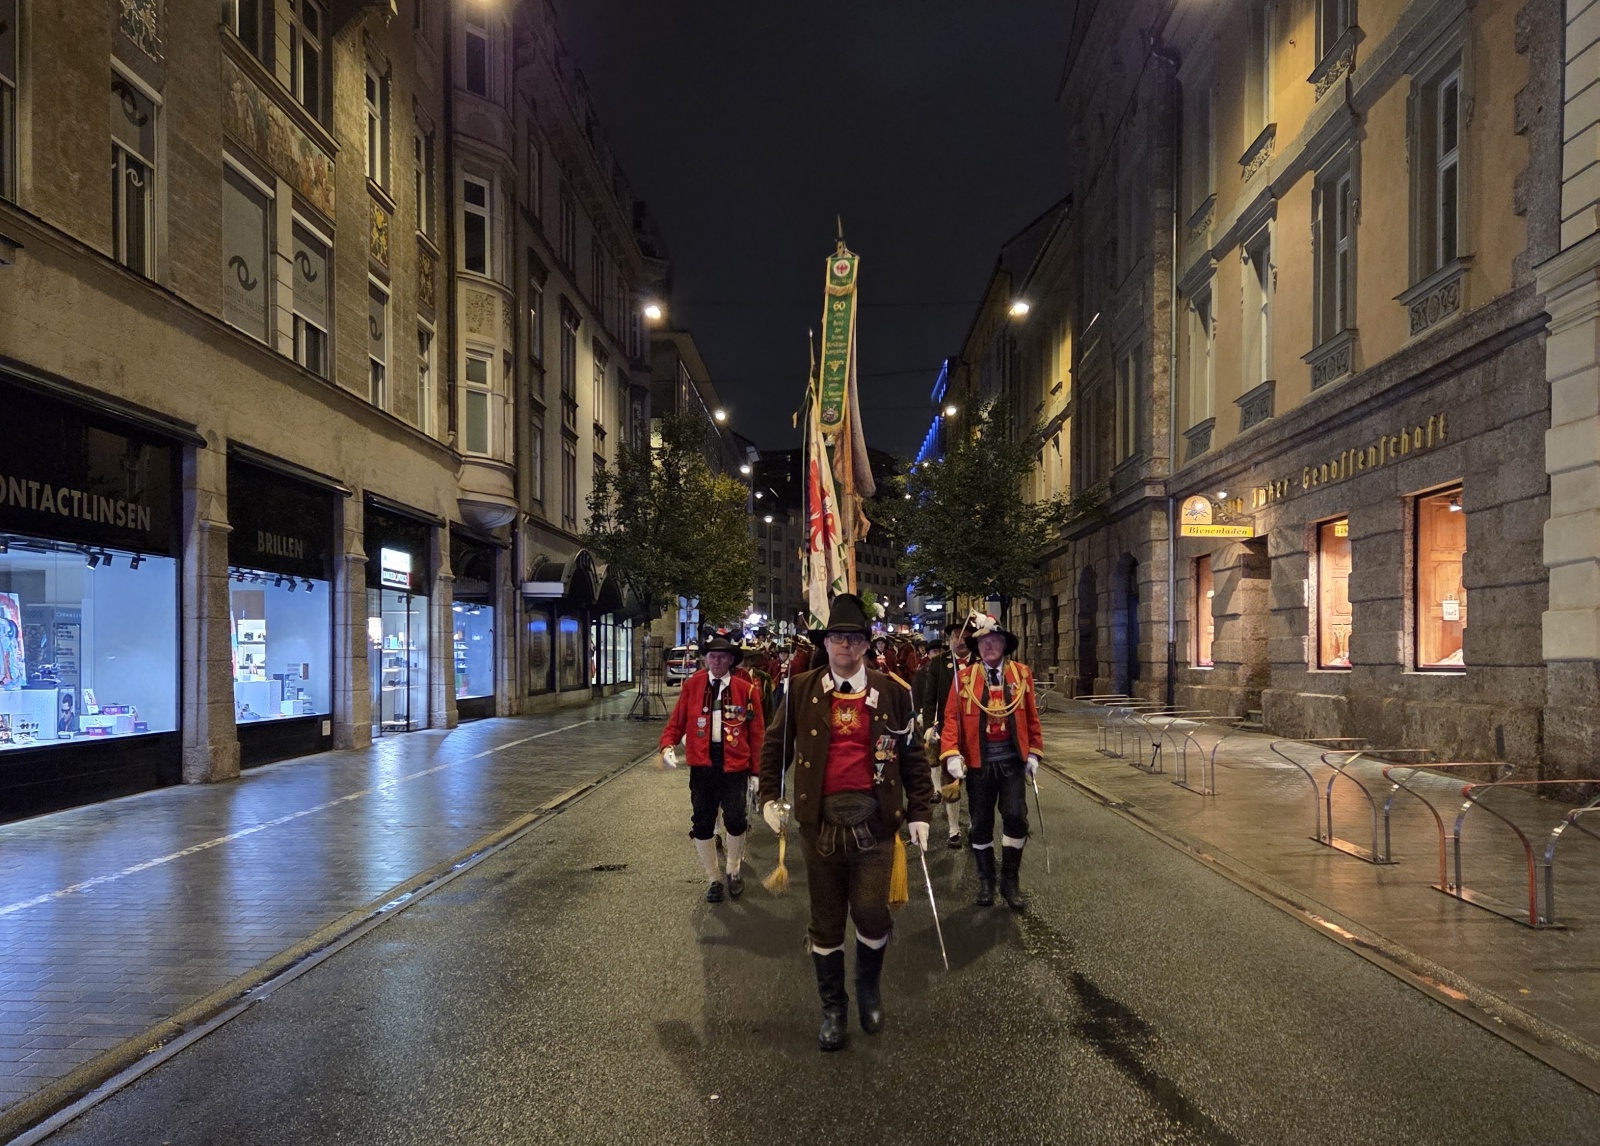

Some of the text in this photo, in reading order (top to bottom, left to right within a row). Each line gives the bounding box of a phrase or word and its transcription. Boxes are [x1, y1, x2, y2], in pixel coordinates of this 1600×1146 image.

[832, 300, 846, 311] 60
[1188, 526, 1248, 535] Bienenladen
[257, 530, 304, 560] BRILLEN
